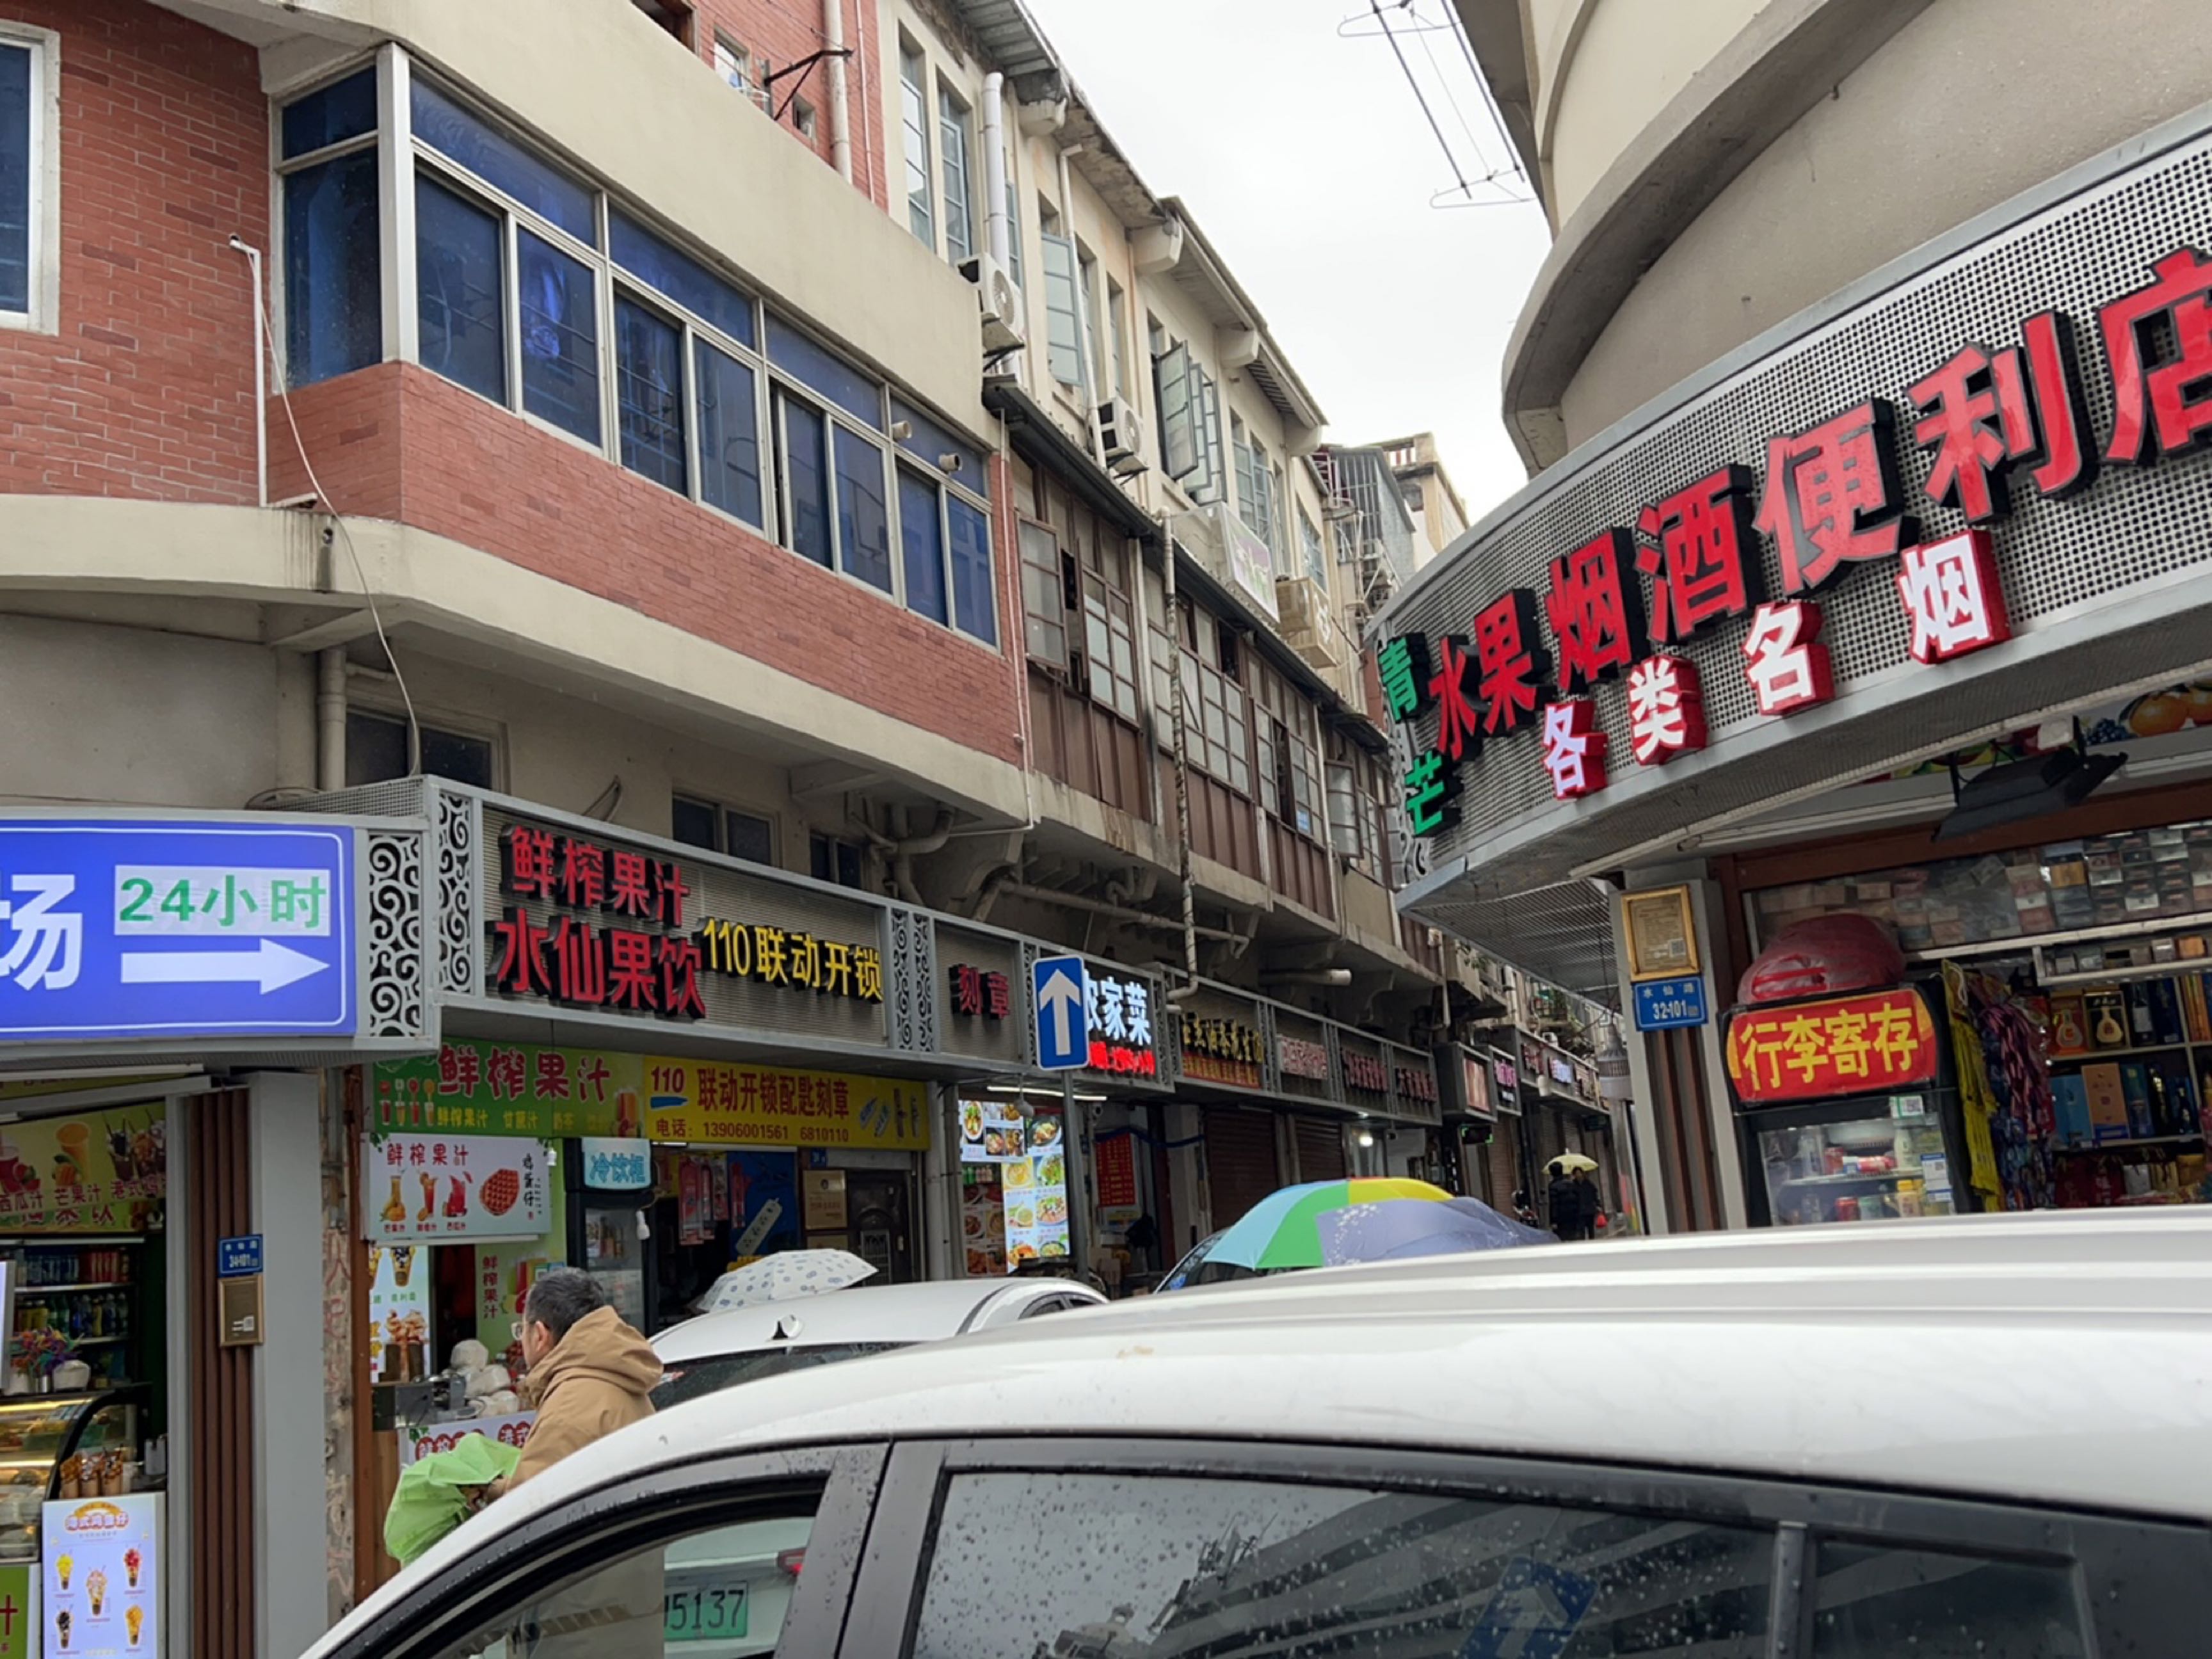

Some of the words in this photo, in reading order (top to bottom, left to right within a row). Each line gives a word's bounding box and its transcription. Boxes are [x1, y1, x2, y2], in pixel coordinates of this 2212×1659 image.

[1429, 247, 2212, 762] 水果烟酒便利店
[1543, 533, 1990, 798] 各类名烟
[1378, 637, 1445, 833] 青芒
[118, 874, 327, 929] 24小时
[510, 824, 691, 928] 鲜榨果汁
[495, 907, 707, 1019] 水仙果饮
[959, 963, 1011, 1020] 刻章
[438, 1044, 611, 1103] 鲜榨果汁
[1740, 1002, 1919, 1092] 行李寄存
[650, 1066, 685, 1094] 110
[696, 1068, 849, 1120] 联动开锁配匙刻章
[387, 1142, 469, 1167] 鲜榨果汁
[704, 1121, 789, 1141] 13906001561
[799, 1126, 849, 1143] 6810110
[54, 1183, 101, 1206] 芒果汁
[483, 1254, 498, 1319] 鲜榨果汁
